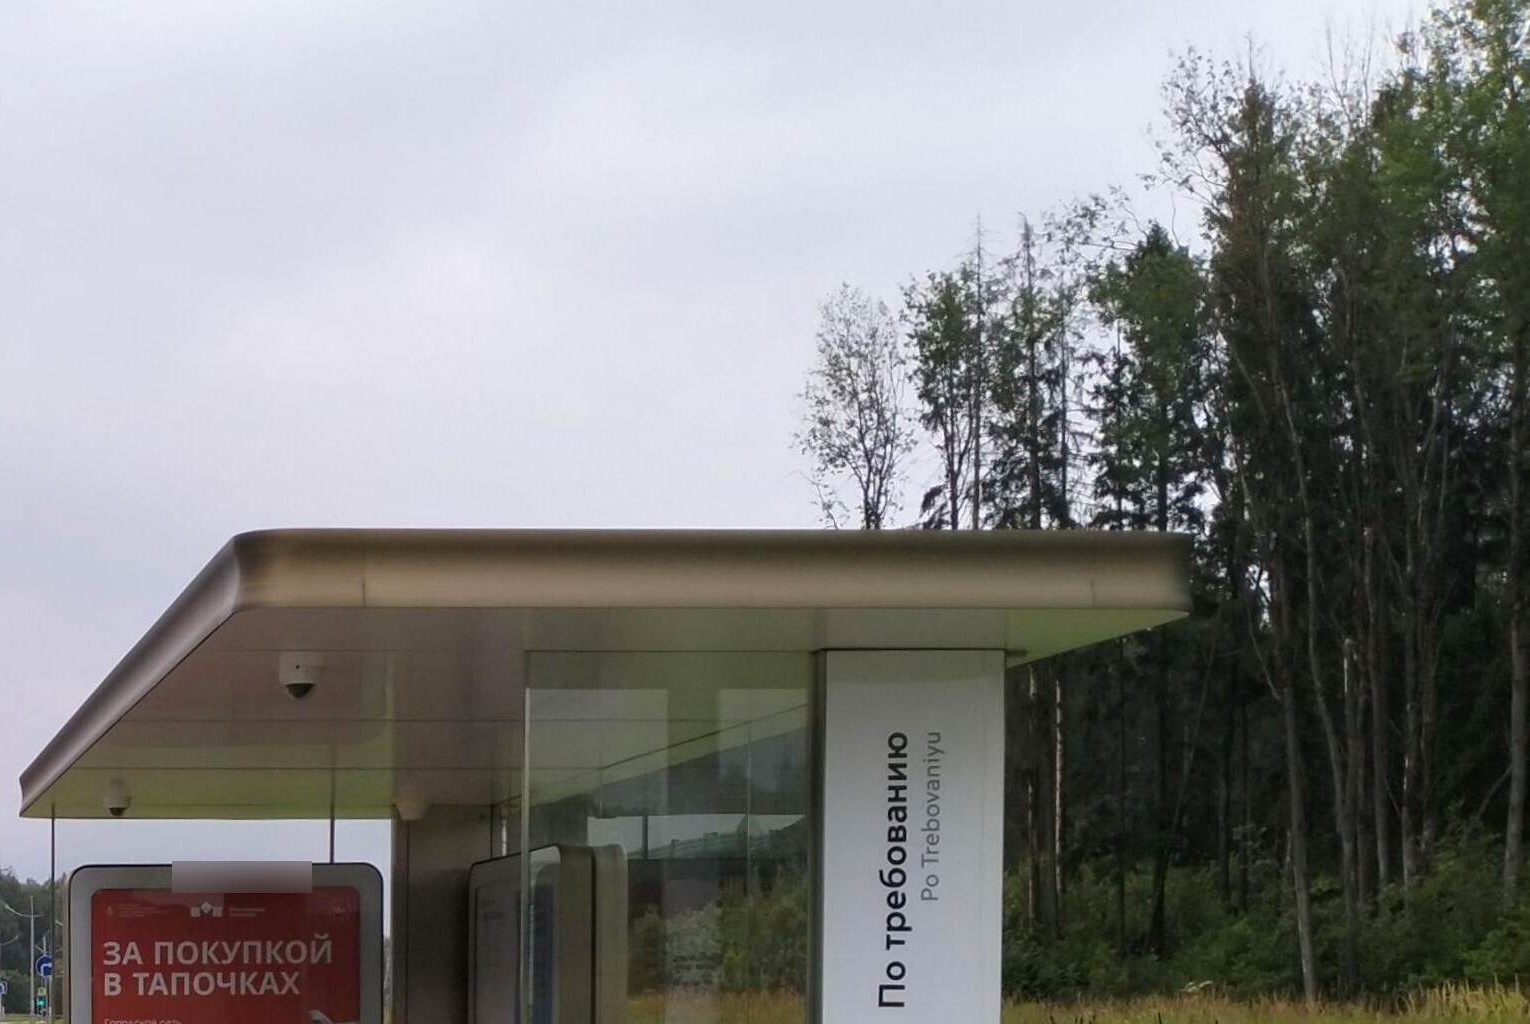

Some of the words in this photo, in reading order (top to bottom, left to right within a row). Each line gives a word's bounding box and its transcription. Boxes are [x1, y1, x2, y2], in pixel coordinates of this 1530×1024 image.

[920, 731, 945, 869] Trebovaniyu
[879, 731, 913, 951] требованию
[920, 873, 940, 902] Po
[102, 940, 144, 966] ЗА
[154, 933, 333, 966] ПОКУПКОЙ
[103, 972, 122, 997] В
[132, 971, 301, 997] ТАПОЧКАХ
[878, 961, 906, 1008] По
